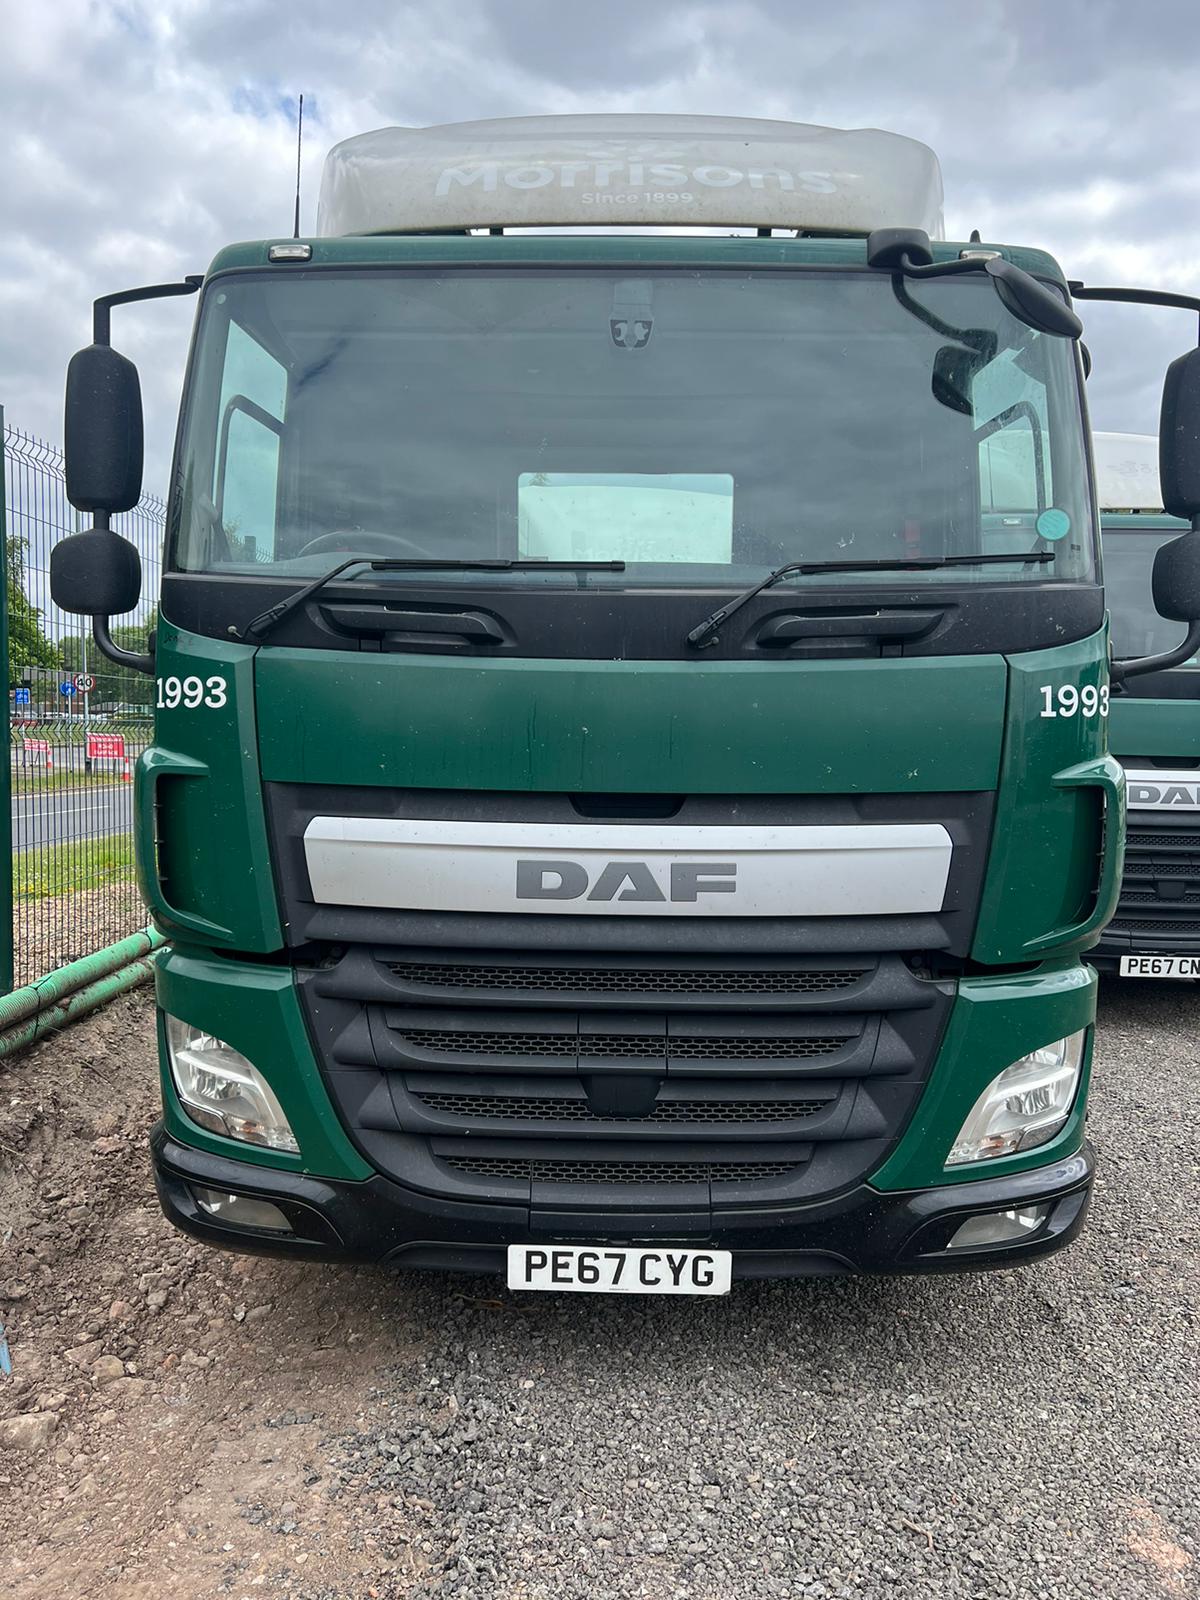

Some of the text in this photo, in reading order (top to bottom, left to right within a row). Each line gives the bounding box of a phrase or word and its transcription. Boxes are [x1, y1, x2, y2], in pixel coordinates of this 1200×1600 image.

[435, 157, 838, 196] Morrisons
[581, 192, 693, 204] Since 1899
[77, 678, 92, 687] 40
[156, 675, 227, 709] 1993
[1040, 685, 1109, 718] 1993
[1128, 785, 1200, 804] DA
[516, 860, 737, 902] DAF
[1128, 957, 1174, 974] PE67
[525, 1250, 714, 1287] PE67 CYG
